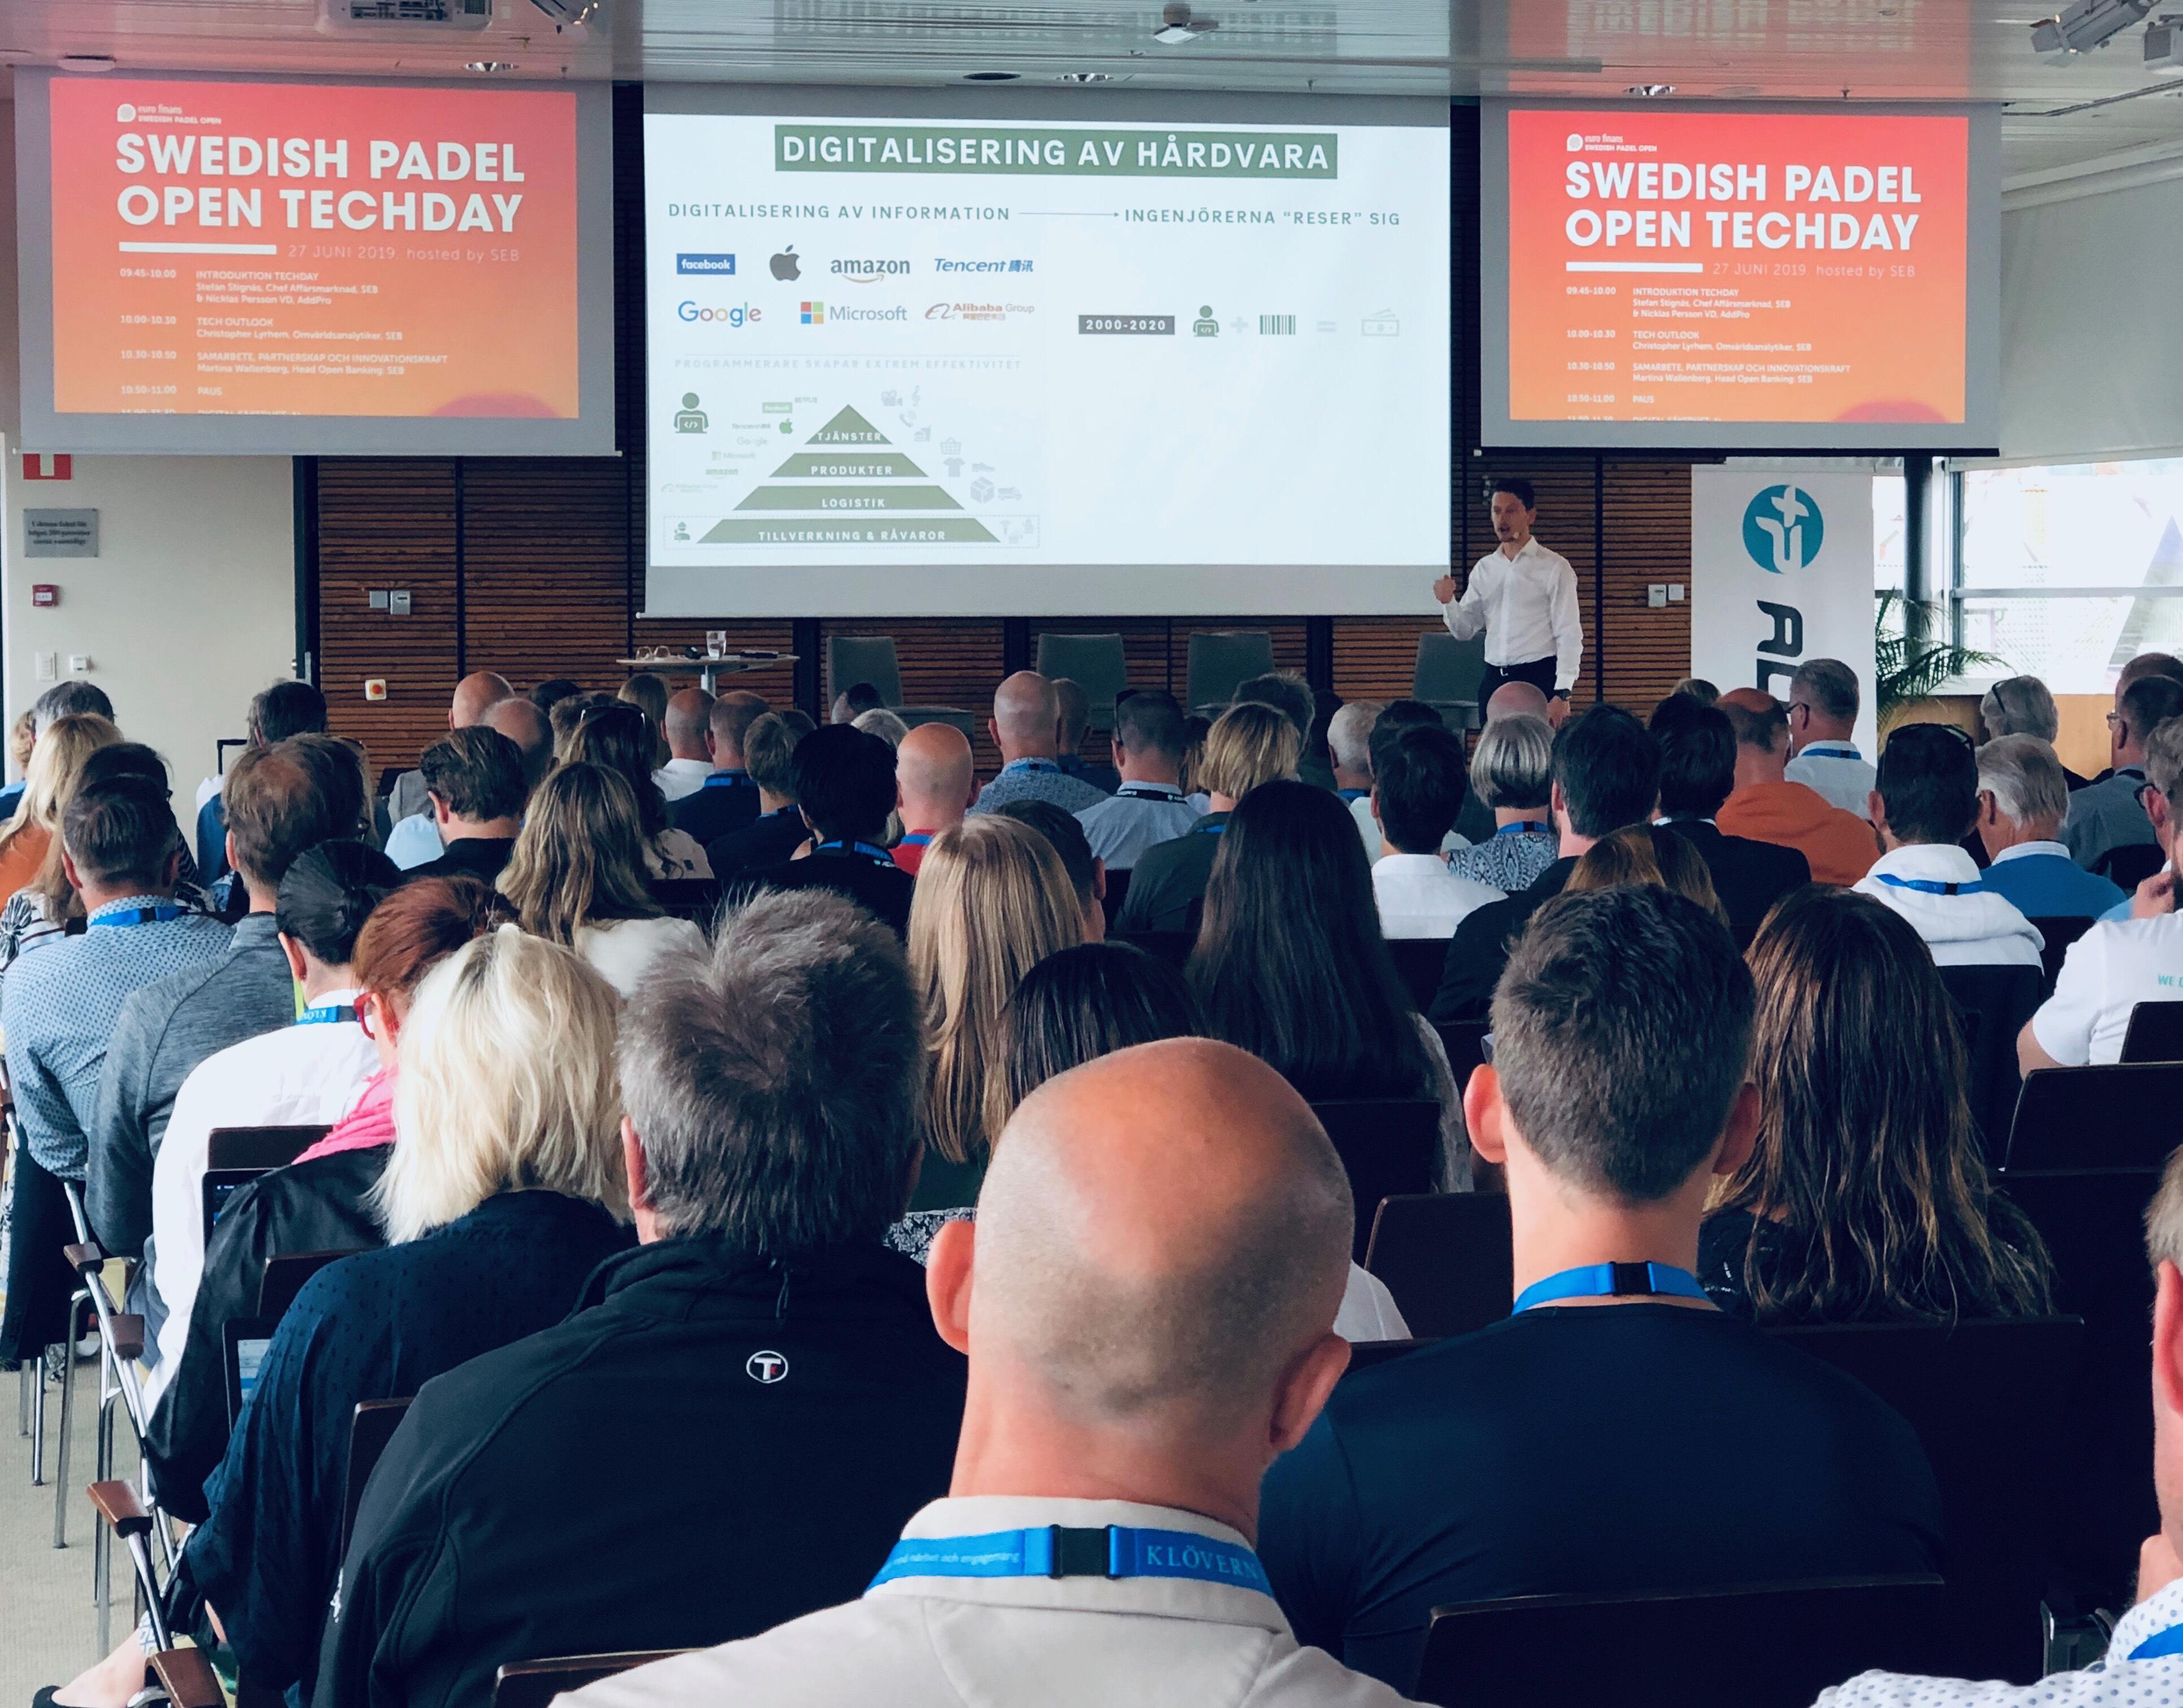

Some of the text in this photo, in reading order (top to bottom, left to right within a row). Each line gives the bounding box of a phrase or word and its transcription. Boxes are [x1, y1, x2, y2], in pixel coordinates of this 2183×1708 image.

[783, 134, 1329, 169] DIGITALISERING AV HÅRDVARA
[116, 133, 525, 182] SWEDISH PADEL
[1566, 161, 1921, 203] SWEDISH PADEL
[117, 185, 523, 232] OPEN TECHDAY
[669, 203, 1010, 220] DIGITALISERING AV INFORMATION
[1125, 207, 1275, 224] INGENJÖRERNA
[1370, 212, 1400, 225] SIG
[1566, 209, 1919, 251] OPEN TECHDAY
[289, 245, 306, 258] 27
[313, 246, 351, 258] JUNI
[407, 247, 460, 260] hosted
[467, 249, 483, 263] by
[491, 249, 520, 262] SEB
[681, 258, 731, 270] facebook
[830, 259, 910, 274] amazon
[934, 258, 1006, 272] Tencent
[196, 271, 319, 281] INTRODUKTION TECHDAY
[1713, 263, 1729, 276] 27
[1734, 264, 1768, 276] JUNI
[1816, 264, 1863, 277] hosted
[1869, 265, 1884, 280] by
[1890, 265, 1915, 277] SEB
[196, 282, 225, 291] Stefan
[265, 284, 287, 292] Chef
[360, 285, 378, 294] SEB
[1566, 286, 1616, 295] 09.45-10.00
[1632, 287, 1739, 297] INTRODUKTION TECHDAY
[196, 294, 203, 303] &
[241, 295, 277, 303] Persson
[297, 295, 332, 304] AddPro
[1633, 298, 1658, 307] Stefan
[1775, 300, 1791, 308] SEB
[678, 300, 761, 328] Google
[830, 306, 907, 321] Microsoft
[953, 303, 1035, 314] Alibaba Group
[120, 315, 176, 324] 10.00-10.30
[197, 317, 273, 326] TECH OUTLOOK
[1086, 319, 1166, 332] 2000-2020
[197, 328, 252, 339] Christopher
[385, 331, 403, 340] SEB
[1567, 329, 1615, 338] 10.00-10.30
[1633, 341, 1681, 351] Christopher
[1796, 343, 1811, 351] SEB
[258, 352, 326, 361] PARTNERSKAP
[328, 353, 350, 362] OCH
[352, 354, 448, 363] INNOVATIONSKRAFT
[197, 364, 232, 372] Martina
[292, 365, 315, 373] Head
[318, 365, 343, 375] Open
[387, 366, 404, 375] SEB
[675, 359, 1021, 369] PROGRAMMERARE SKAPAR EXTREM EFFEKTIVITET
[1567, 361, 1615, 370] 10.30-10.50
[1685, 363, 1744, 372] PARTNERSKAP
[1746, 364, 1765, 372] OCH
[1767, 364, 1850, 373] INNOVATIONSKRAFT
[1737, 374, 1759, 384] Open
[197, 386, 223, 395] PAUS
[1632, 395, 1654, 403] PAUS
[817, 430, 881, 441] TJÄNSTER
[811, 465, 892, 475] PRODUKTER
[821, 498, 885, 508] LOGISTIK
[759, 528, 945, 541] TILLVERKNING & RÅVAROR
[2158, 975, 2173, 986] WE
